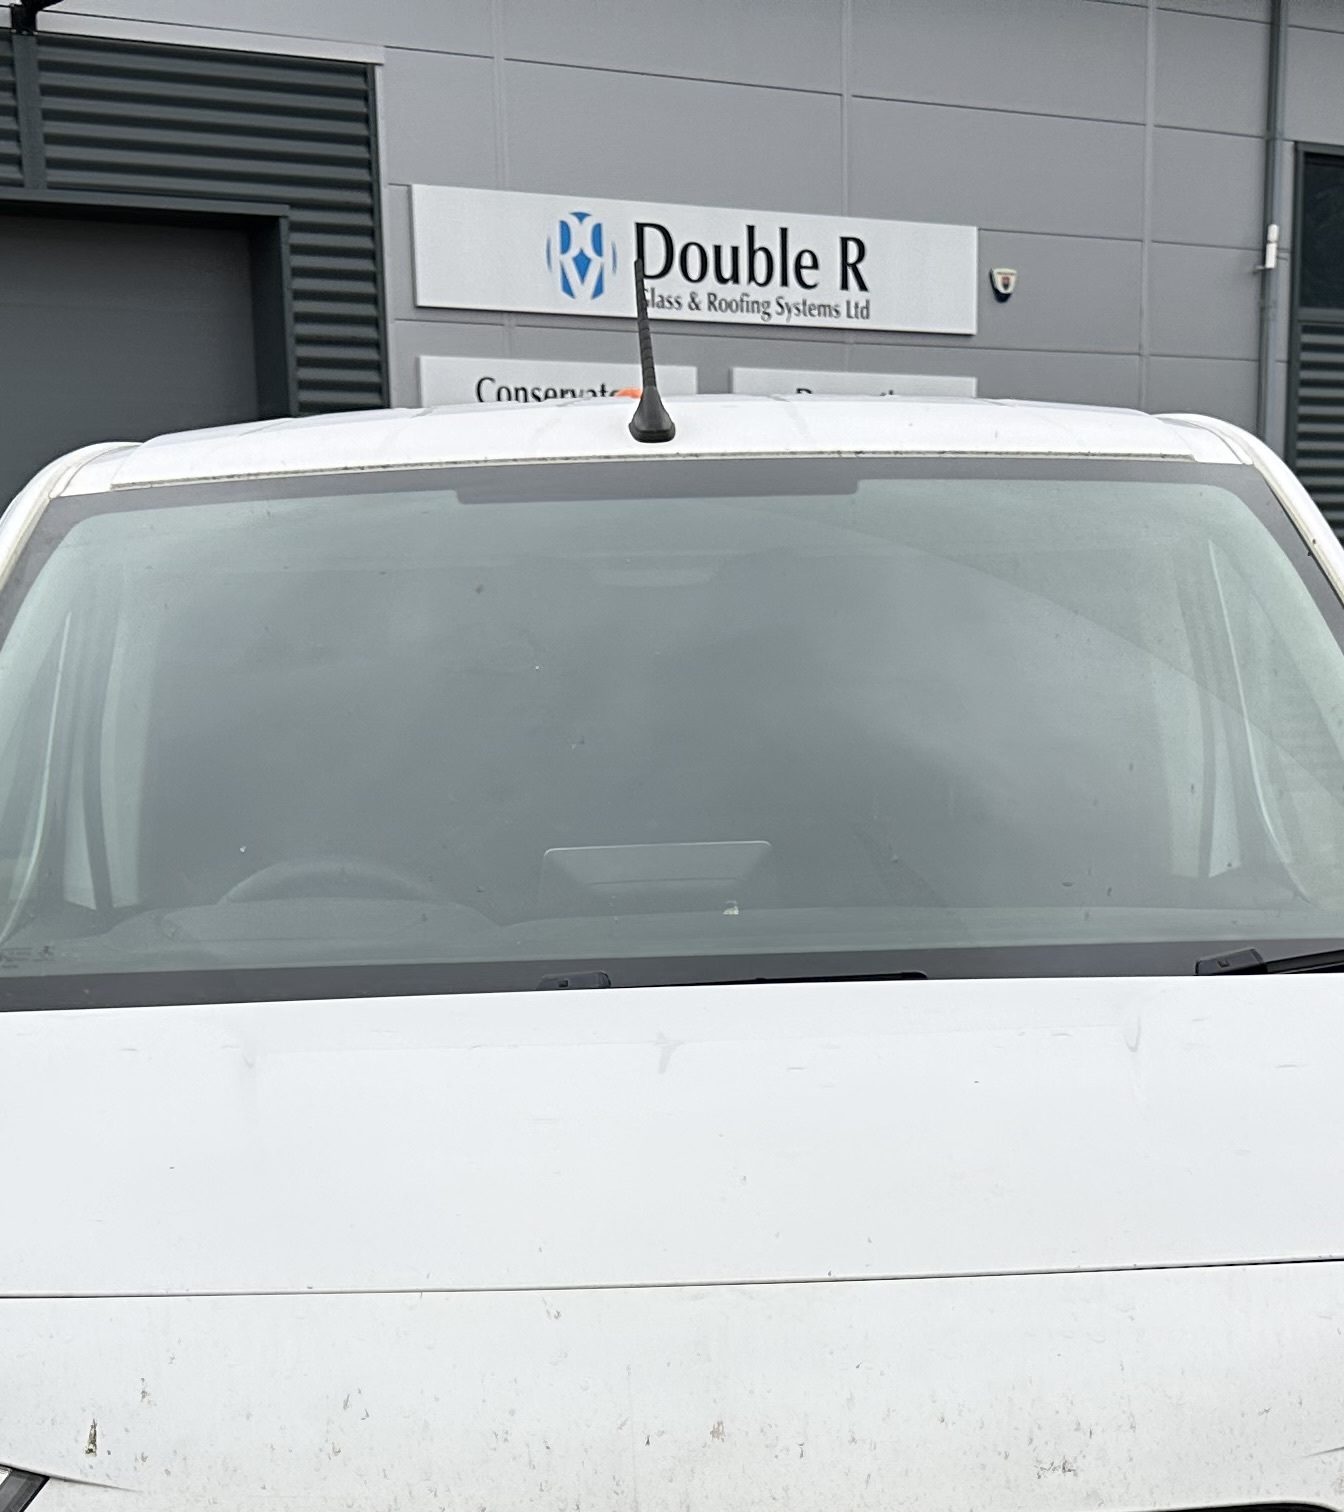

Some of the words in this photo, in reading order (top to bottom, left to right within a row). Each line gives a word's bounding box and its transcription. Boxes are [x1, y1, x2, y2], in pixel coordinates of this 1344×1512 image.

[634, 221, 820, 290] Double
[839, 236, 870, 291] R
[643, 287, 683, 310] lass
[687, 291, 702, 311] &
[707, 292, 772, 321] Roofing
[775, 296, 841, 323] Systems
[846, 299, 870, 320] Ltd
